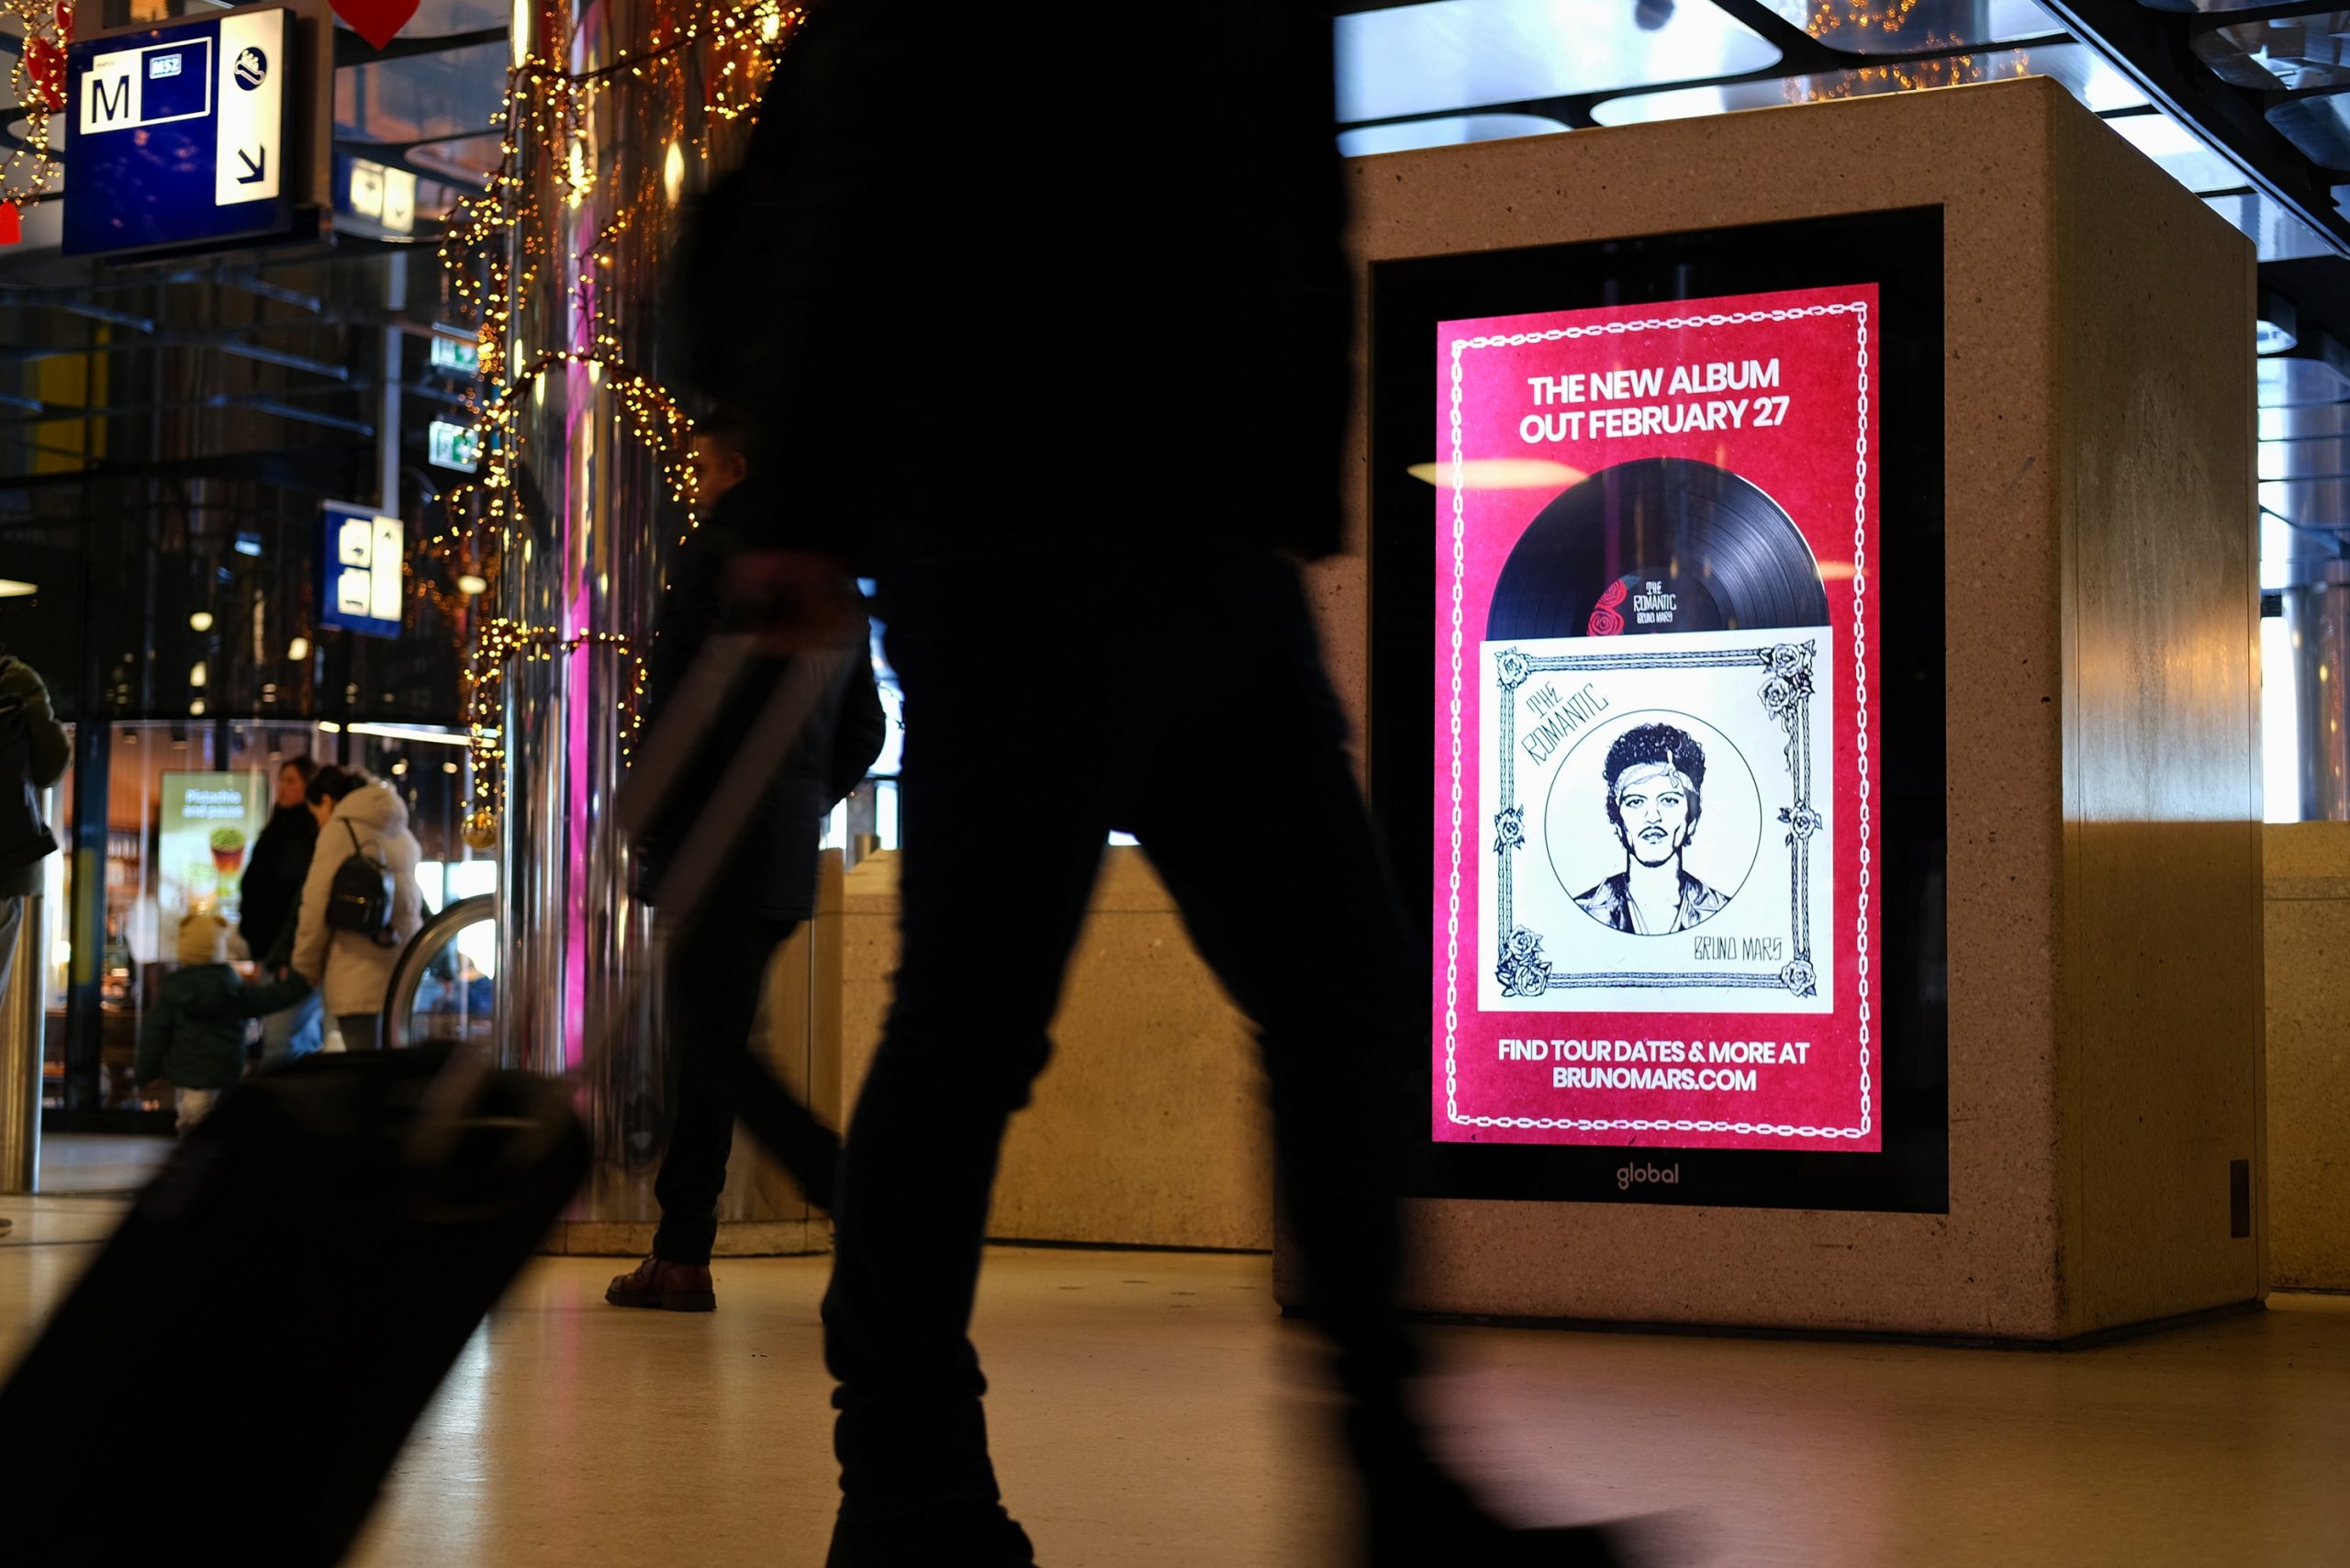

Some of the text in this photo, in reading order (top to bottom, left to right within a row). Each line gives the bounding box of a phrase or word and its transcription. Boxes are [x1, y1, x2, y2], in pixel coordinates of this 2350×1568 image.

[152, 57, 180, 75] M52
[92, 74, 129, 124] M
[1528, 357, 1780, 406] THE NEW ALBUM
[1519, 395, 1790, 444] OUT FEBRUARY 27
[1633, 593, 1677, 612] ROMANTIC
[1645, 581, 1662, 596] THE
[1526, 680, 1563, 720] THE
[1521, 682, 1609, 767] ROMANTIC
[1694, 935, 1783, 962] BRUNO MARS
[1497, 1038, 1811, 1065] FIND TOUR DATES & MORE AT
[1551, 1066, 1757, 1092] BRUNOMARS.COM
[1617, 1161, 1680, 1191] global
